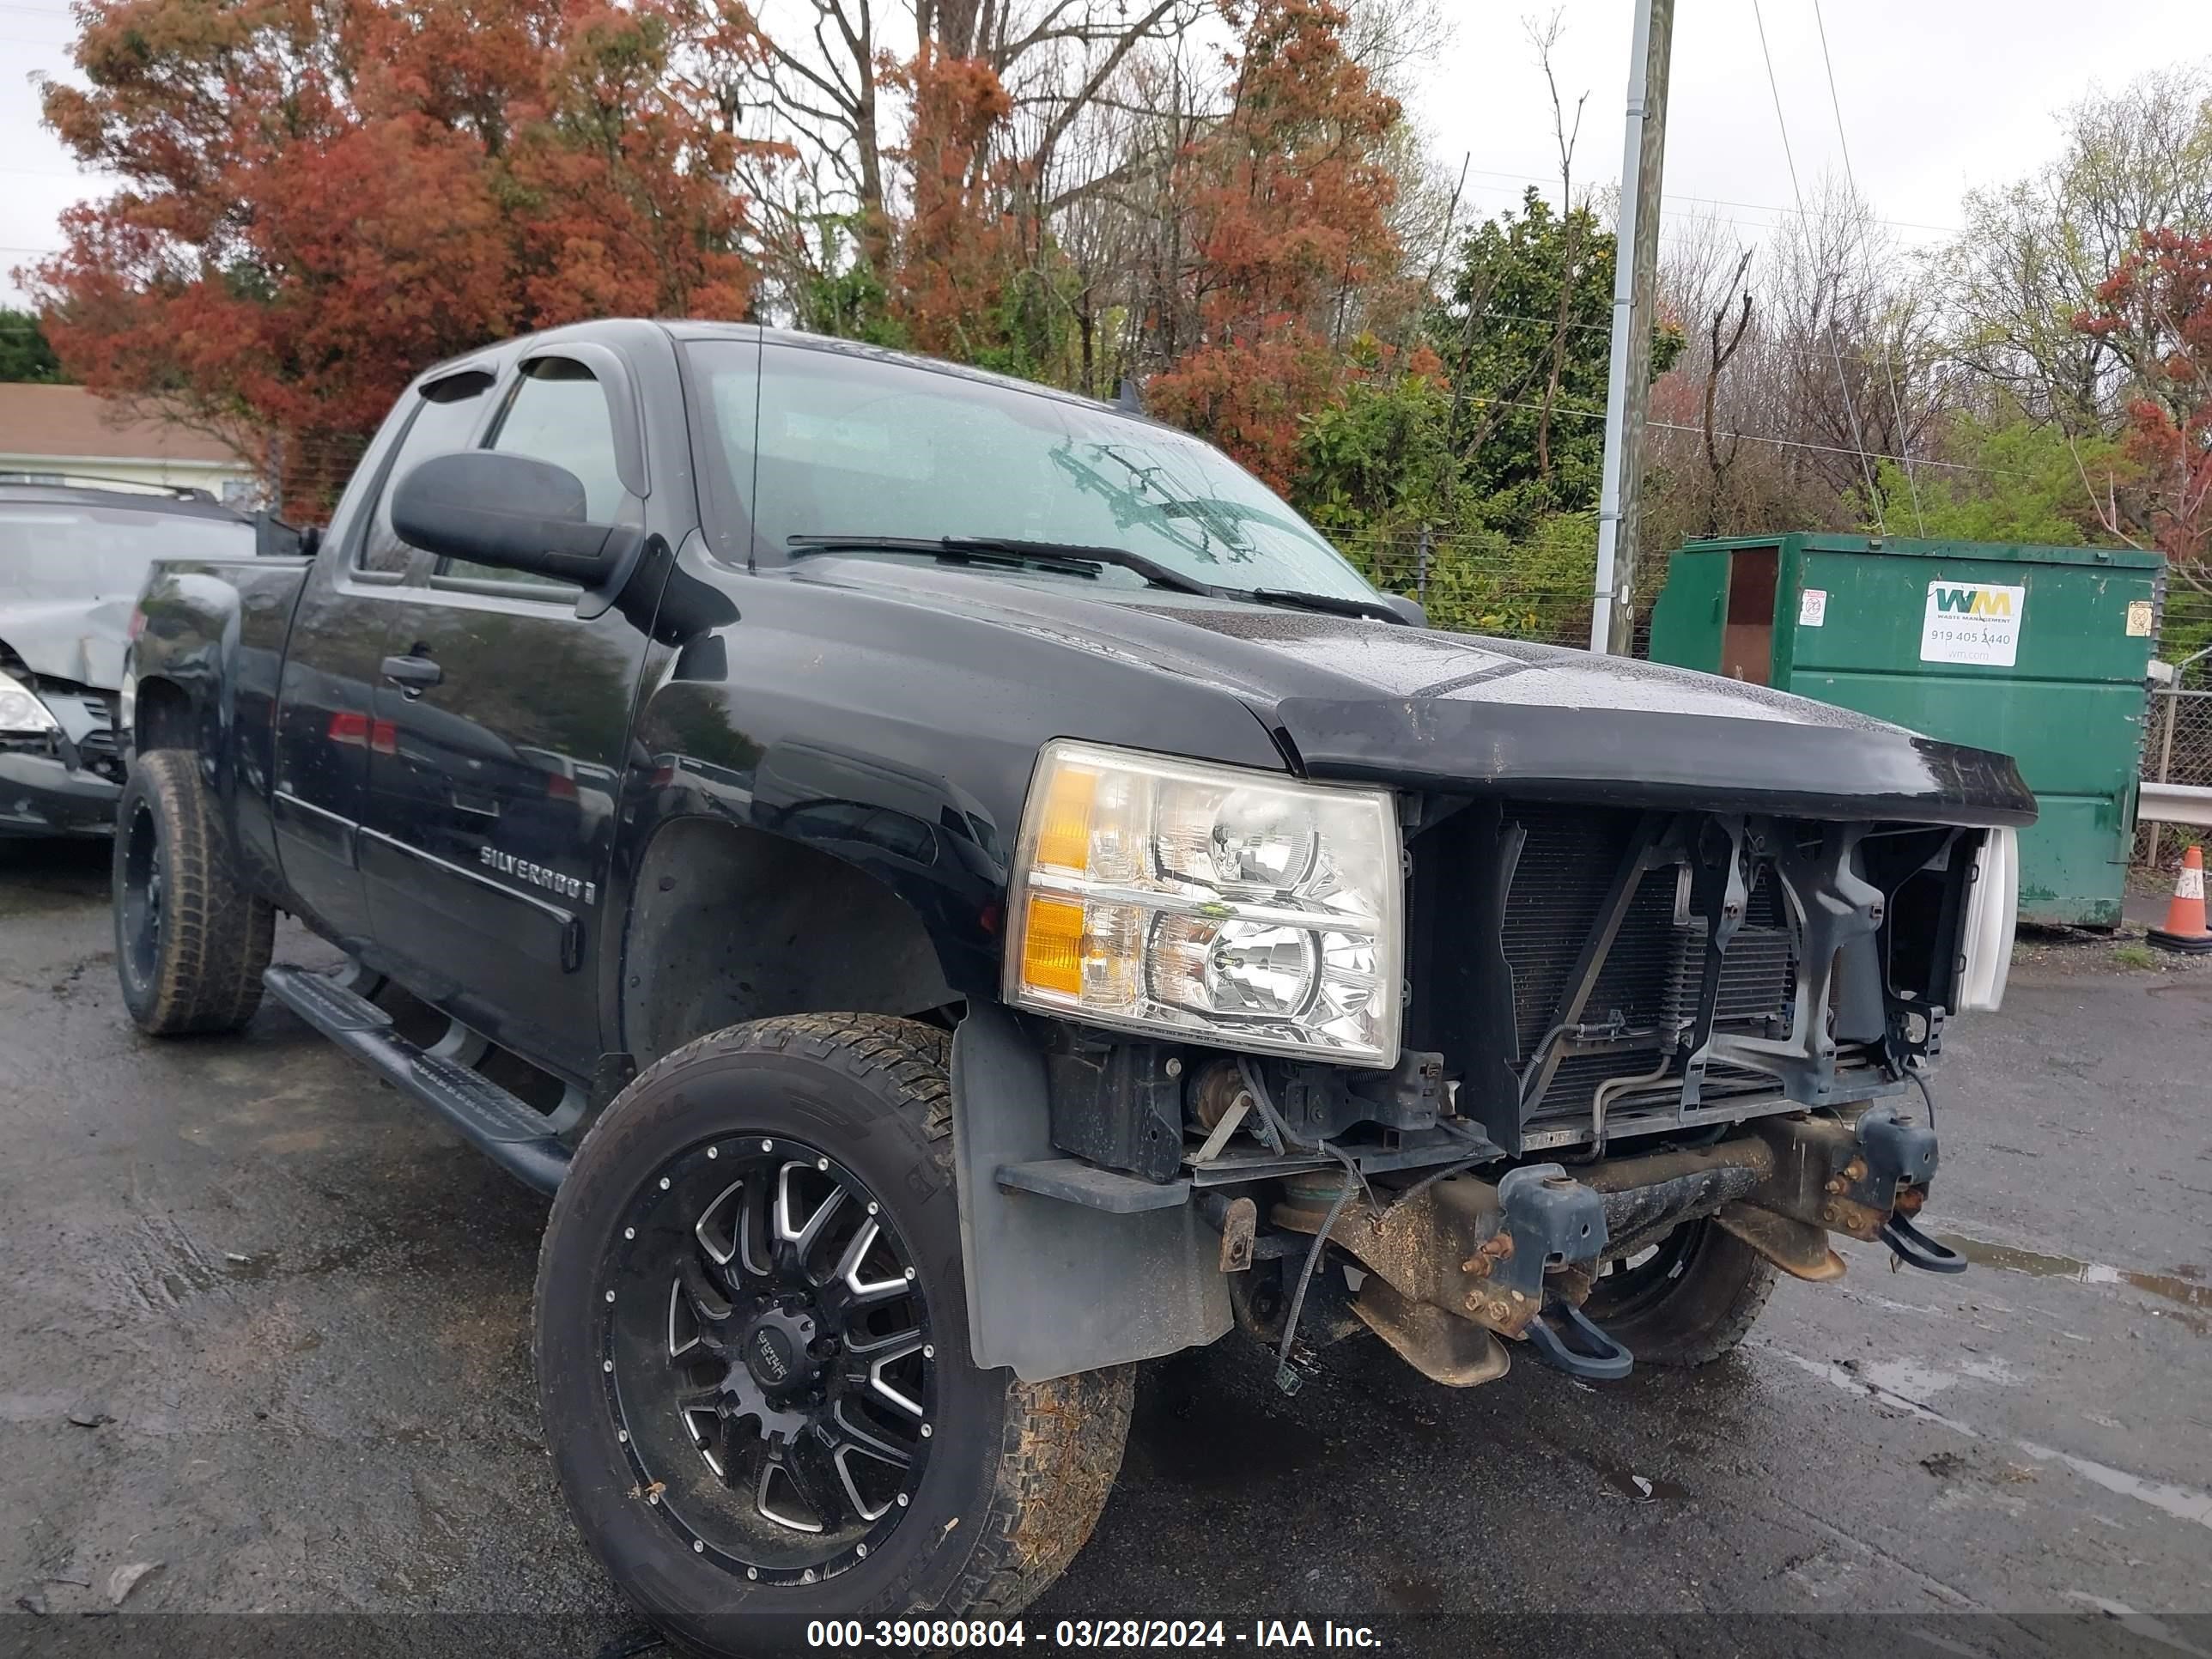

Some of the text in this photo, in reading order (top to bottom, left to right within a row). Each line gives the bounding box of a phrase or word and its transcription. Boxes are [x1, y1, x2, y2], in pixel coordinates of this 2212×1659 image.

[1936, 588, 2011, 615] WM
[1931, 630, 2011, 645] 919 405 2440
[1948, 650, 1990, 660] wm.com
[479, 845, 582, 899] SILVERADO
